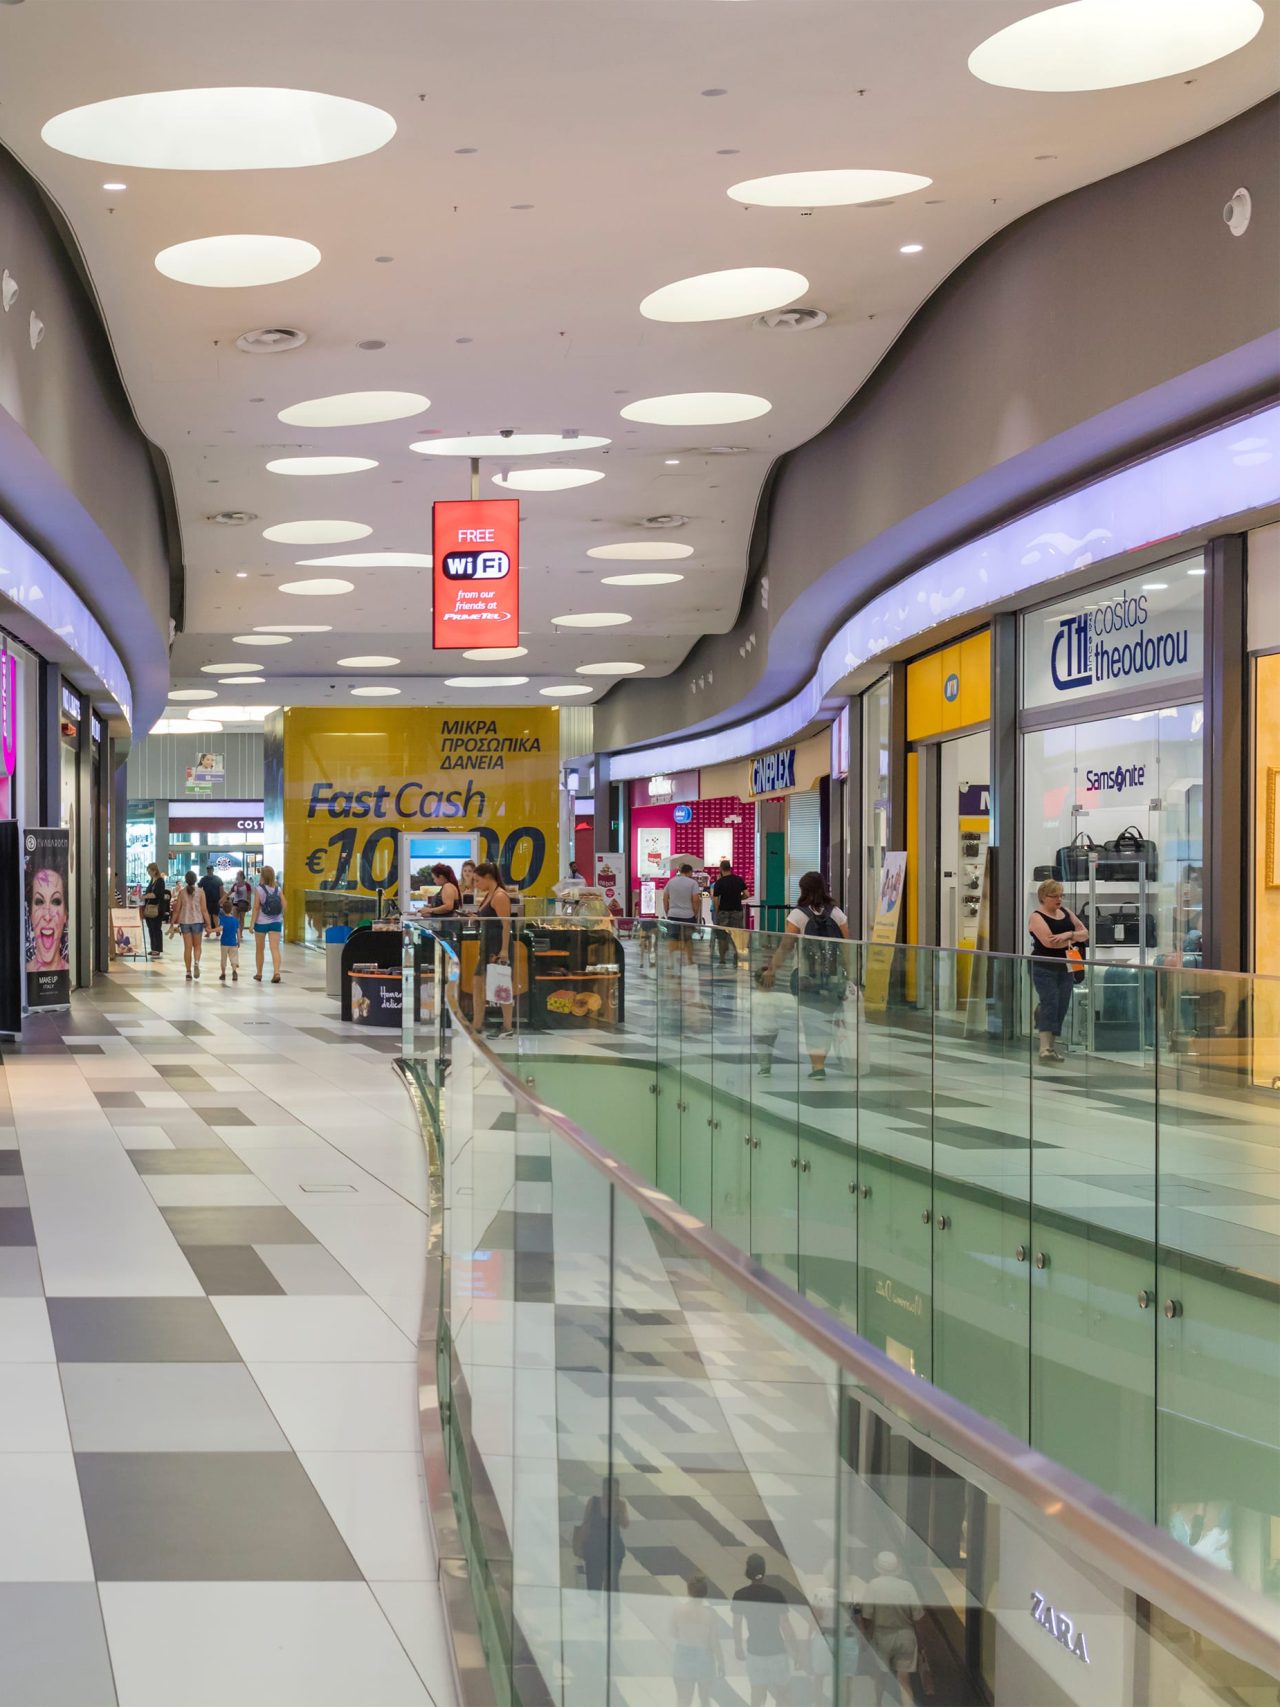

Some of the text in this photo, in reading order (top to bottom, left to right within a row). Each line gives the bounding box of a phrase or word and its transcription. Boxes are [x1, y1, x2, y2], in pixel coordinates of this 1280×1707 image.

[458, 528, 495, 543] FREE
[457, 590, 496, 601] from our
[454, 600, 498, 612] friends at
[1094, 589, 1148, 637] costas
[1094, 629, 1188, 682] theodorou
[440, 720, 497, 735] ΜΙΚΡΑ
[440, 737, 541, 753] ΠΡΟΣΩΠΙΚΑ
[439, 755, 505, 770] ΔΑΝΕΙΑ
[1086, 764, 1145, 792] Samsonite
[307, 779, 486, 819] Fast Cash
[1030, 1591, 1091, 1664] ZARA
